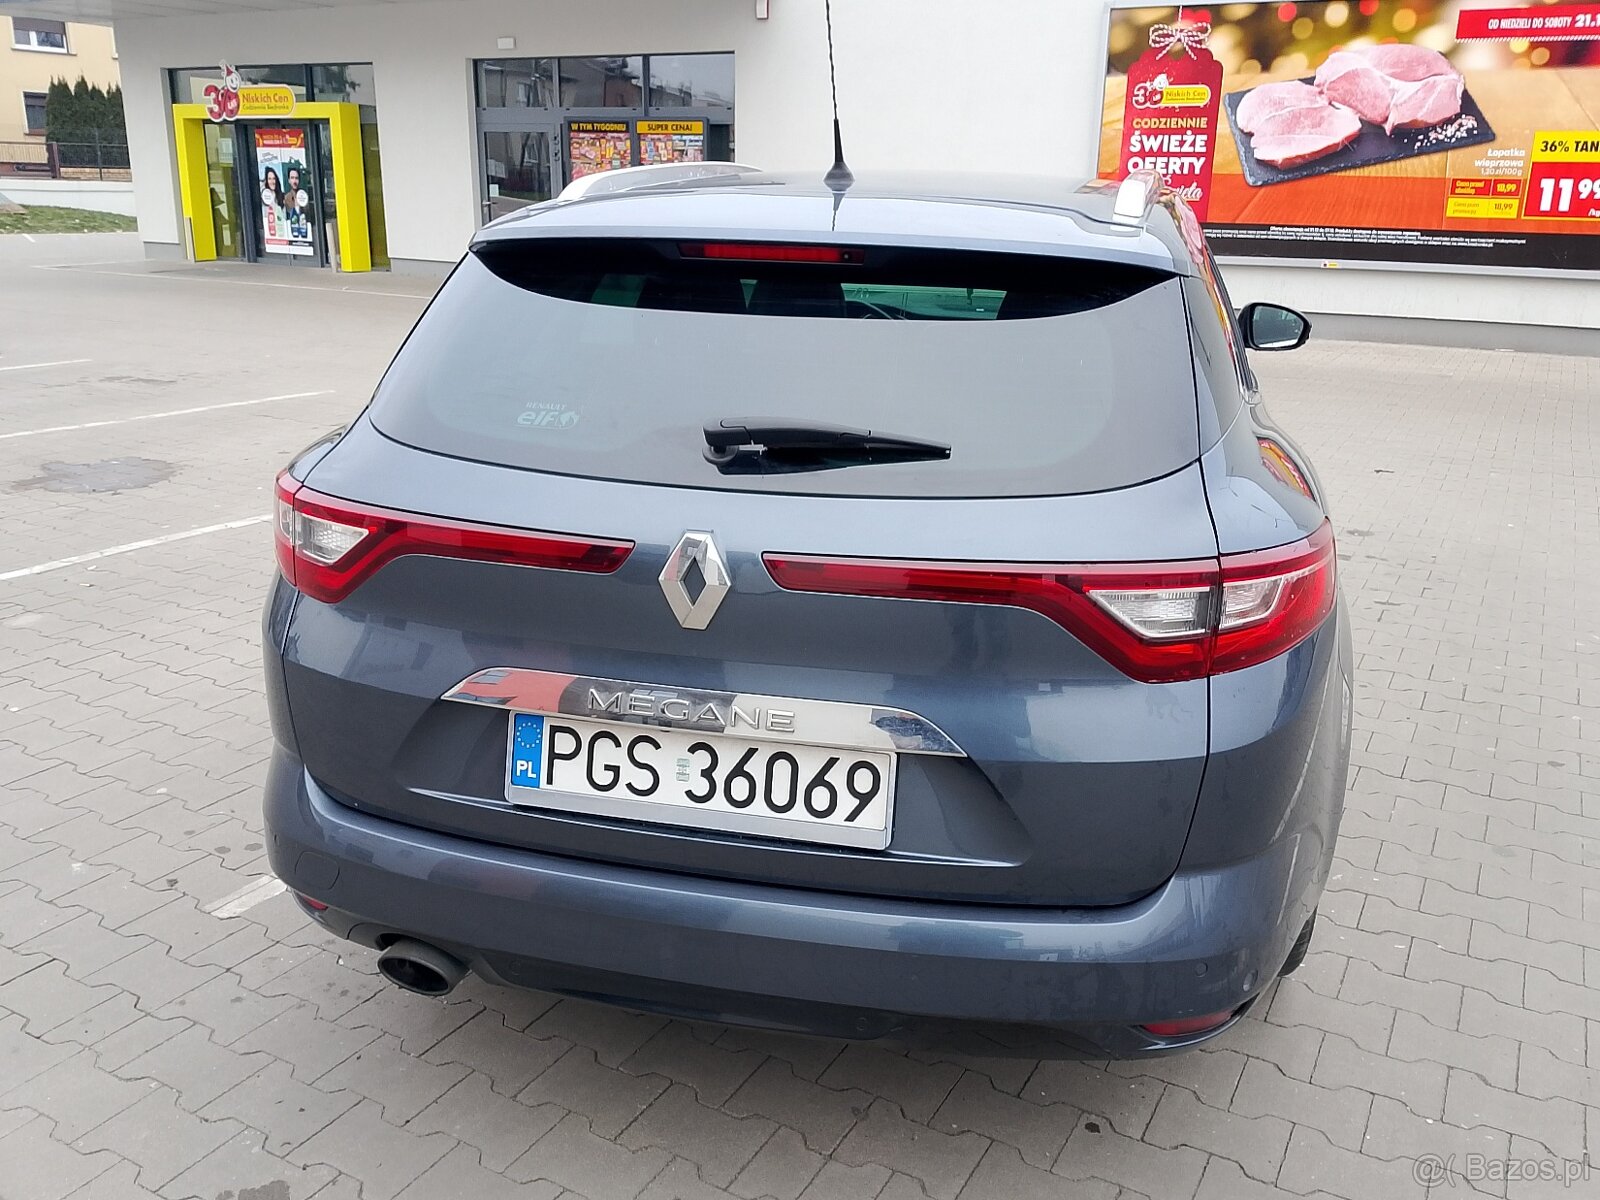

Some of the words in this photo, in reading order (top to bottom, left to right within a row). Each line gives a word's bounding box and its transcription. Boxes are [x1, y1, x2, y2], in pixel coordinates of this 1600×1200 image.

[1532, 17, 1543, 28] DO
[1544, 16, 1572, 28] SOBOTY
[242, 93, 272, 103] Niskich
[273, 93, 289, 103] Cen
[570, 123, 579, 131] W
[579, 123, 593, 131] TYM
[594, 123, 627, 132] TYGODNIU
[647, 123, 669, 131] SUPER
[670, 123, 693, 131] CENA!
[1132, 117, 1208, 129] CODZIENNIE
[1129, 130, 1208, 153] ŚWIEŻE
[1540, 140, 1570, 153] 36%
[1127, 156, 1206, 175] OFERTY
[526, 401, 566, 410] RENAULT
[588, 687, 795, 732] MEGANE
[516, 760, 537, 778] PL
[546, 724, 662, 797] PGS
[684, 741, 881, 822] 36069
